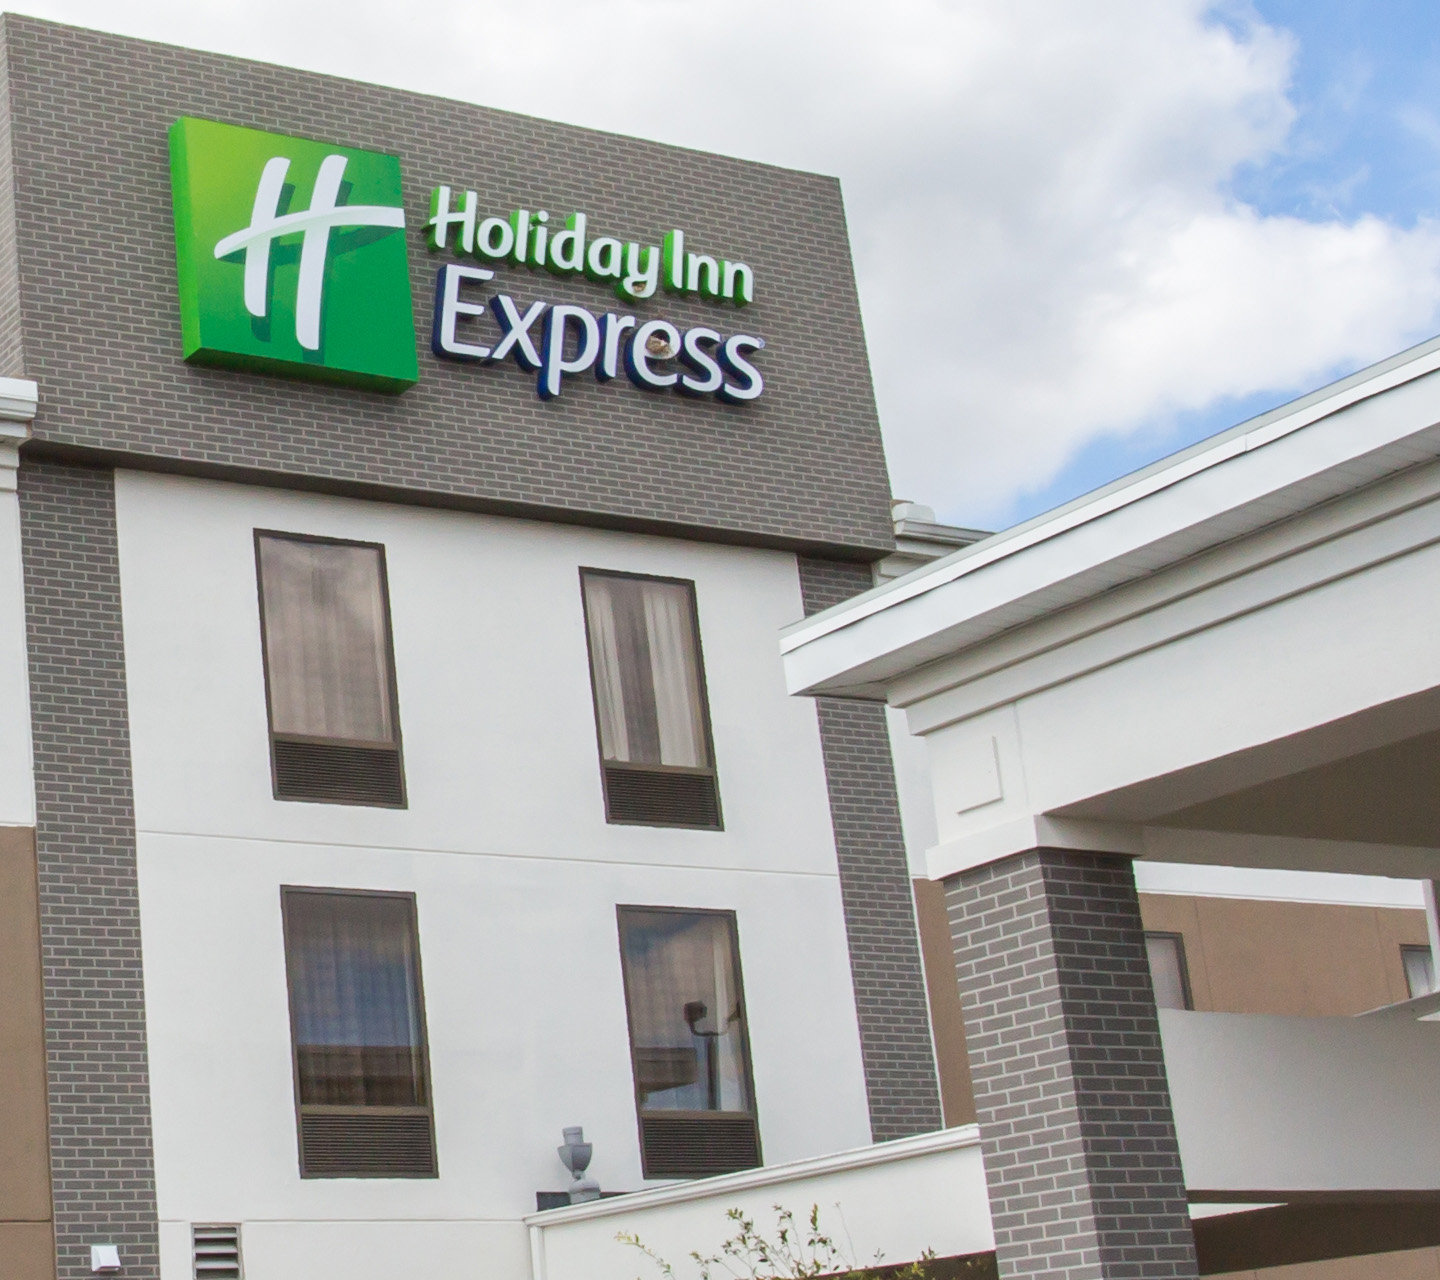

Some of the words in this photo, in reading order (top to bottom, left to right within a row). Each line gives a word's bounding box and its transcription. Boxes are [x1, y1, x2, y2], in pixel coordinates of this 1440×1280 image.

[423, 185, 660, 300] Holiday
[665, 228, 755, 305] Inn
[432, 263, 767, 401] Express
